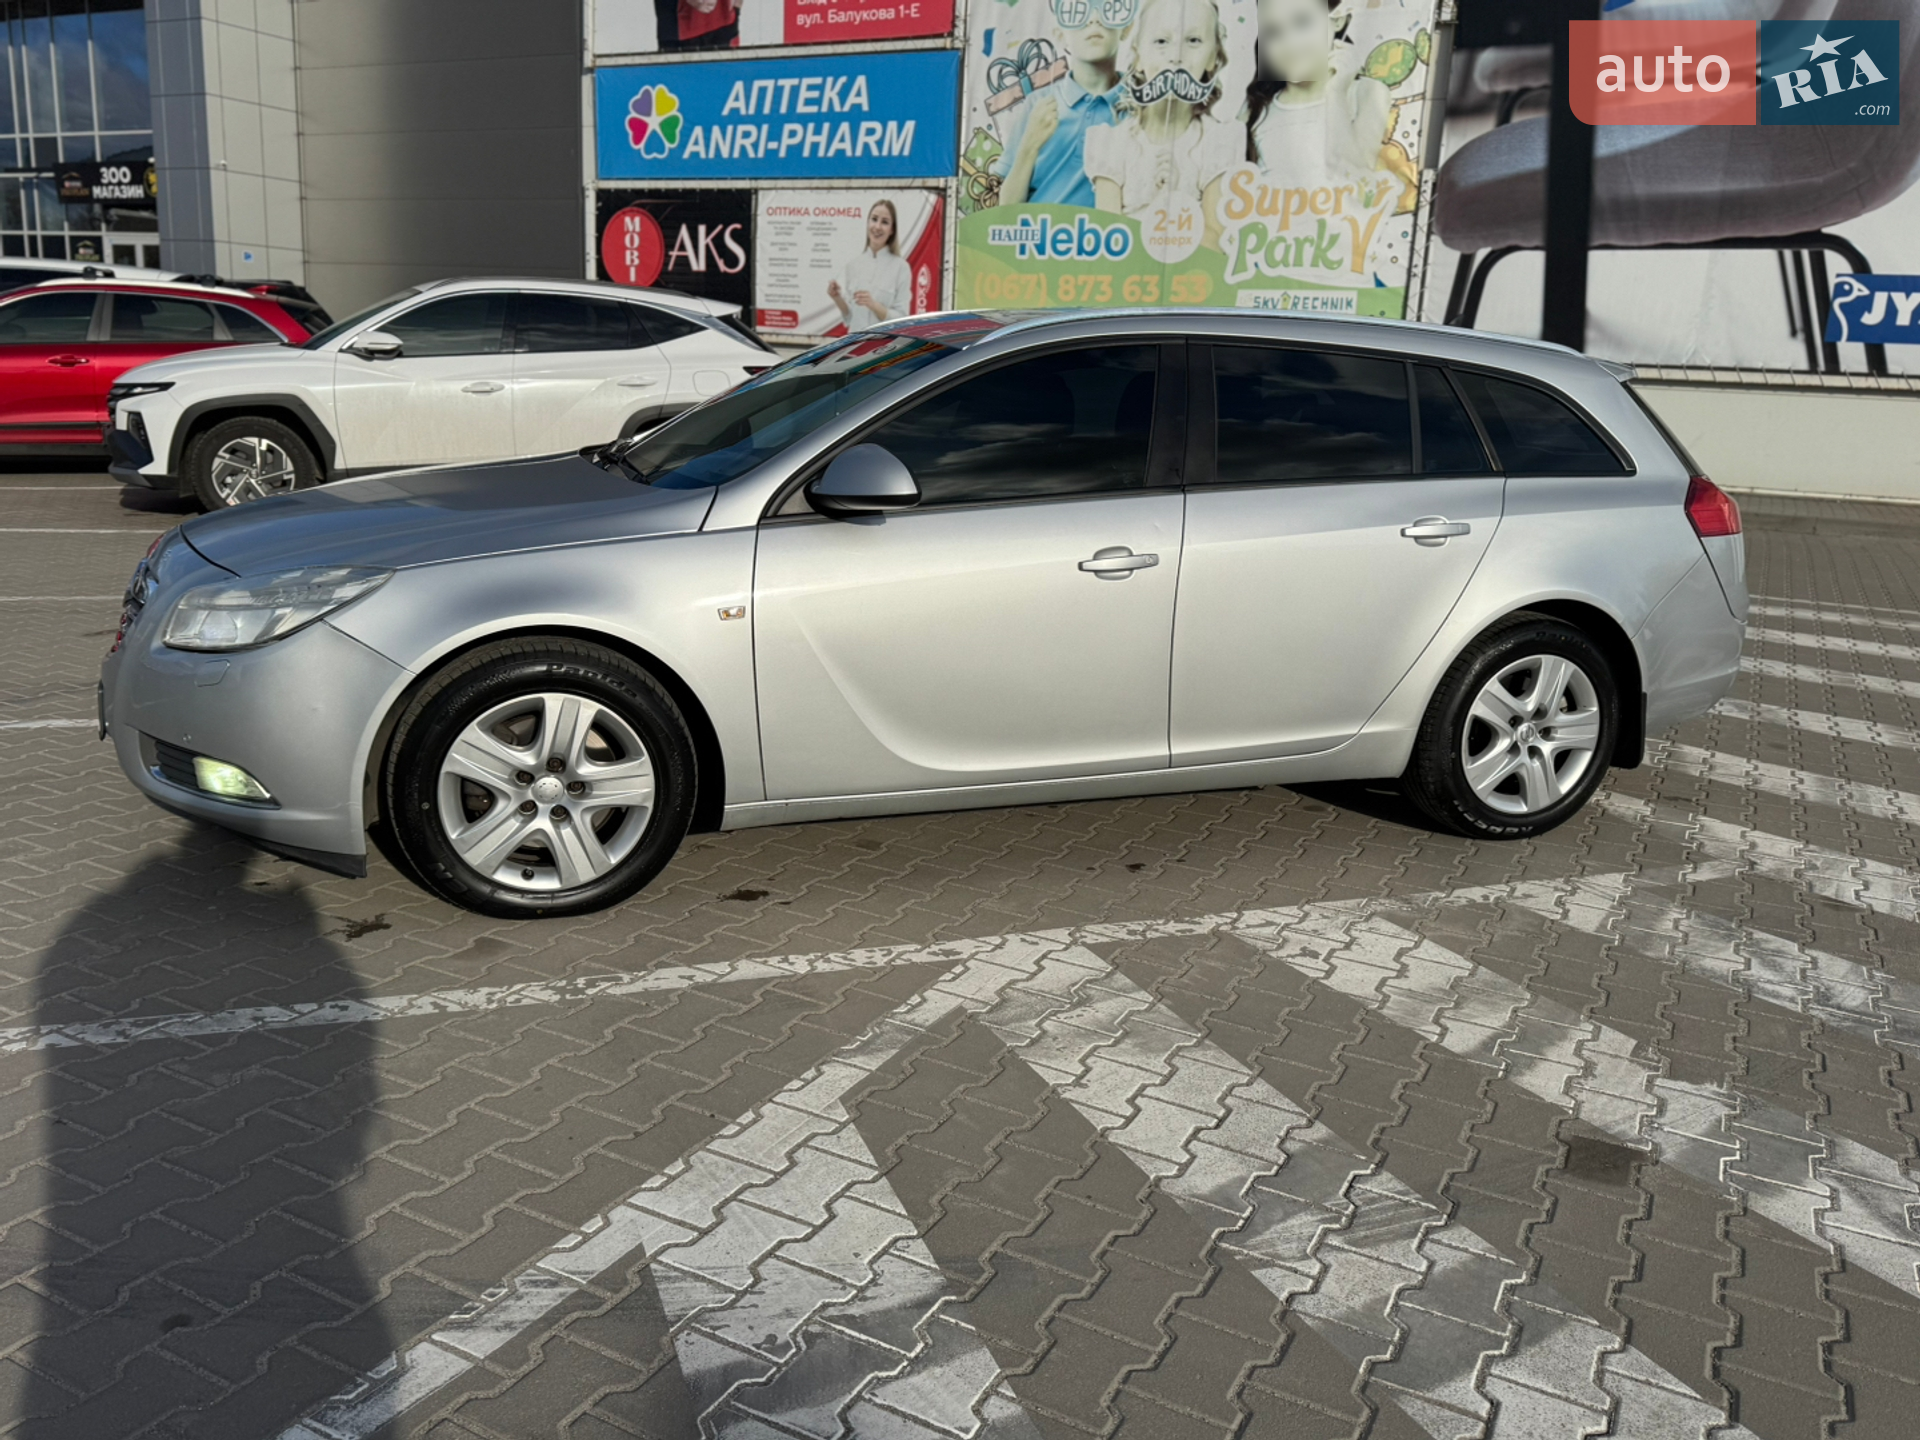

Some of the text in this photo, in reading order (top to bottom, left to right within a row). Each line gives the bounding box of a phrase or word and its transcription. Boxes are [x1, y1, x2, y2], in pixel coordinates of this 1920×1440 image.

[796, 13, 824, 28] вул.
[827, 7, 895, 25] Балукова
[721, 75, 870, 117] АПТЕКА
[682, 120, 917, 160] ANRI-PHARM
[92, 185, 144, 199] МАГАЗИН
[1224, 170, 1356, 233] Super
[766, 206, 862, 218] ОПТИКА ОКОМЕД
[668, 222, 747, 274] AKS
[991, 228, 1040, 242] НАШЕ
[1018, 217, 1131, 258] Nebo
[1149, 235, 1193, 248] поверх
[1231, 218, 1344, 276] Park
[974, 272, 1208, 307] (067) 873 63 53
[1860, 291, 1920, 327] JY
